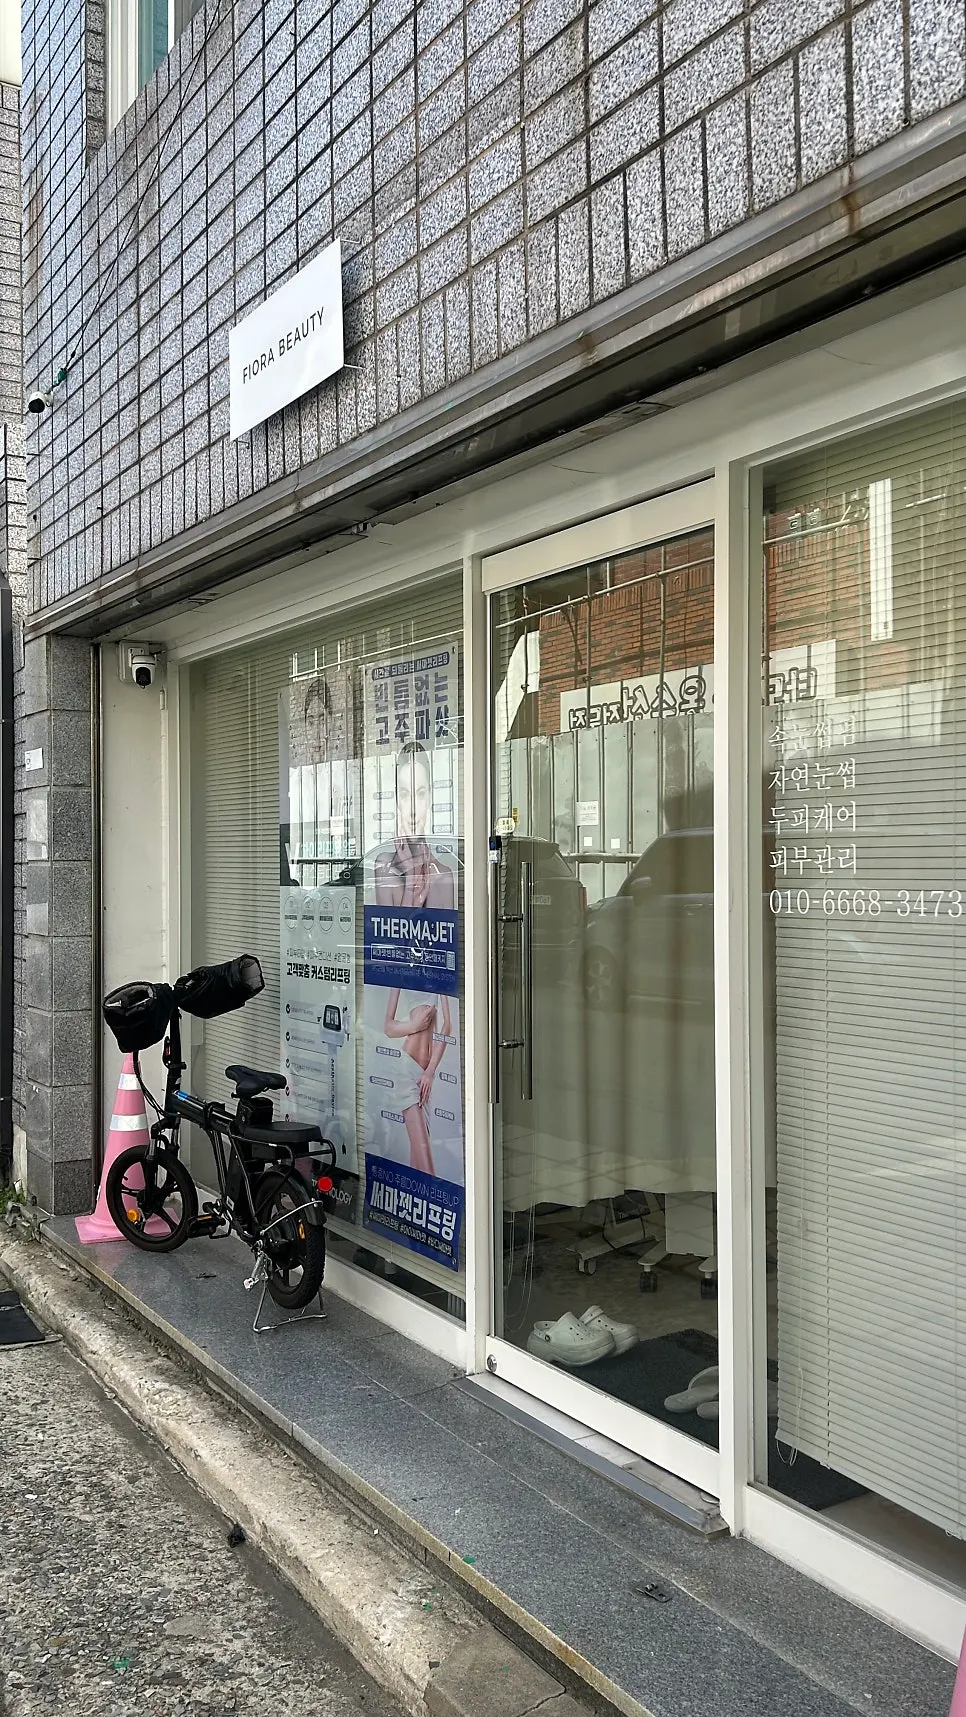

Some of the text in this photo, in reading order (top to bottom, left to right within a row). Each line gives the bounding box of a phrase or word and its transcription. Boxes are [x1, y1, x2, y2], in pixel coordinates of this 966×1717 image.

[242, 306, 325, 384] FIORA BEAUTY
[374, 671, 449, 713] 빈틈없는
[768, 714, 857, 754] 속눈썹펌
[767, 757, 857, 795] 자연눈썹
[768, 800, 857, 835] 두피케어
[769, 843, 857, 876] 피부관리
[769, 889, 963, 918] 010-6668-3473
[370, 917, 455, 943] THERMAJET
[286, 962, 351, 984] 고객맞춤 커스텀리프팅
[370, 1180, 457, 1241] 써마젯리프팅
